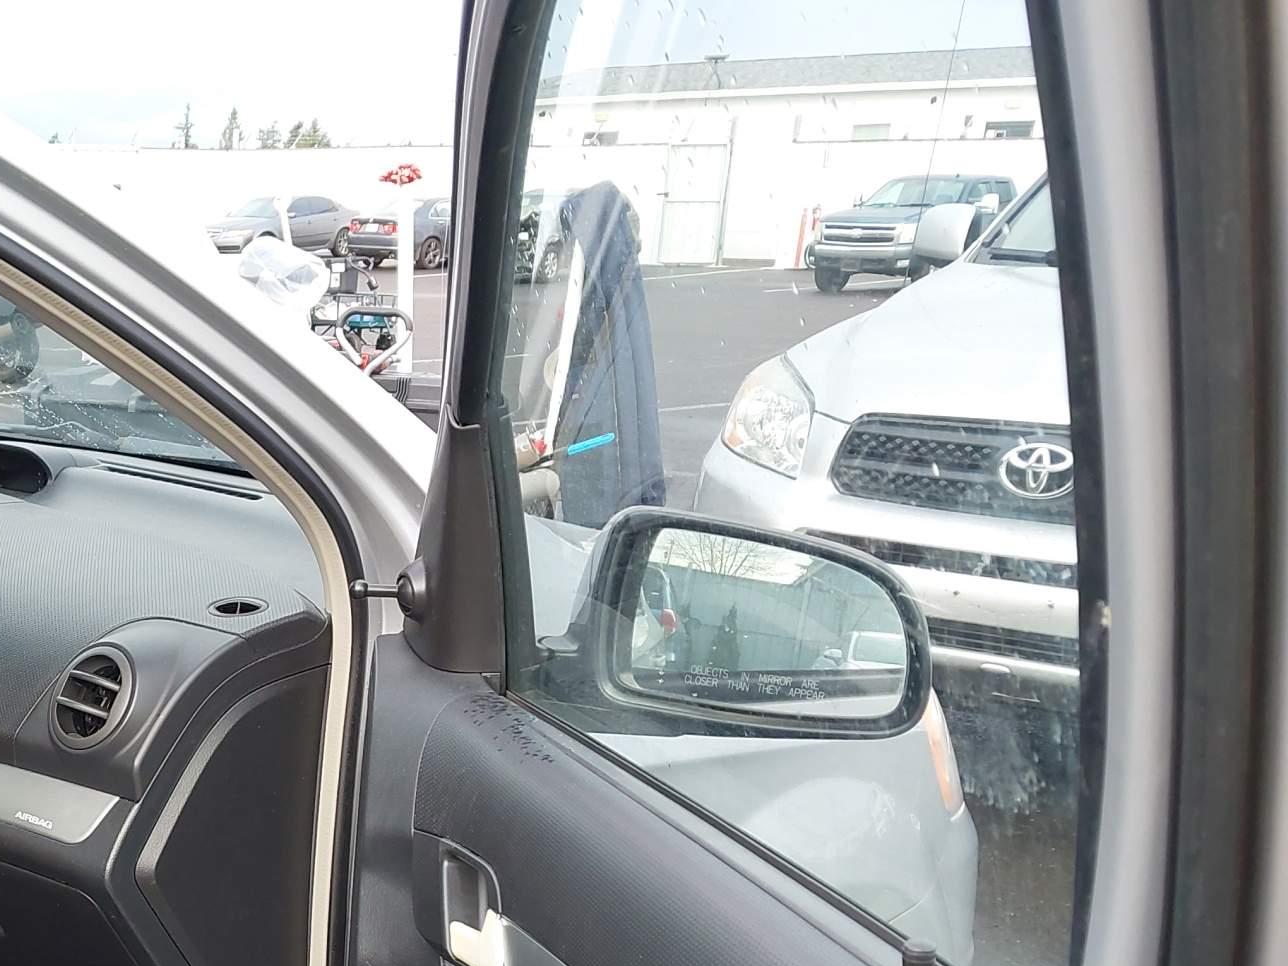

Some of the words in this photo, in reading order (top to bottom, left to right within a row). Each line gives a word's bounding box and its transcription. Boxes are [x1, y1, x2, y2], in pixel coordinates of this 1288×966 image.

[685, 674, 719, 687] CLOSER
[728, 680, 750, 692] THAN
[758, 683, 781, 695] THEY
[789, 687, 824, 700] APPEAR
[691, 665, 729, 679] OBJECTS
[740, 671, 750, 682] IN
[759, 673, 792, 686] MIRROR
[801, 679, 819, 690] ARE
[14, 811, 53, 829] AIRBAG
